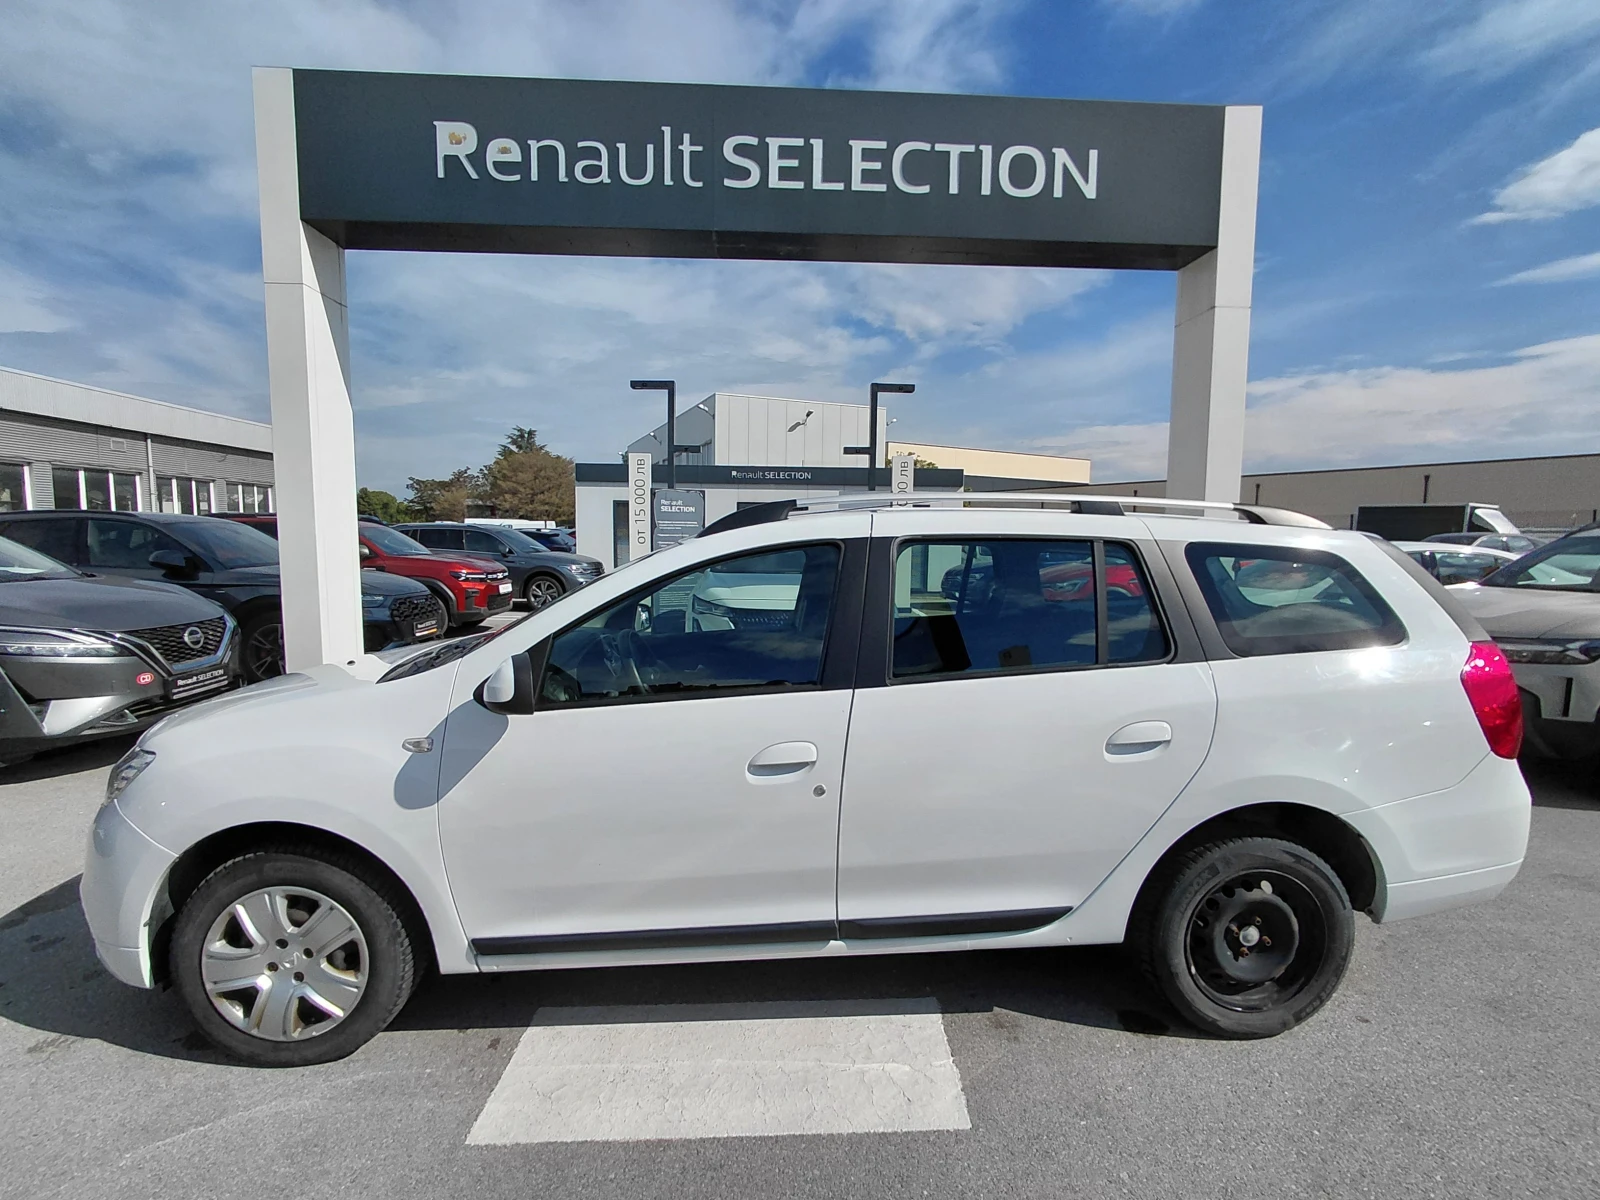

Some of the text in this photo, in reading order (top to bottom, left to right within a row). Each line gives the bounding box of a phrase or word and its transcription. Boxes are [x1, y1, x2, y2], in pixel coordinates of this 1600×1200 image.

[432, 120, 1099, 200] Renault SELECTION
[731, 470, 812, 480] Renault SELECTION
[634, 478, 646, 505] 000
[634, 508, 646, 524] 15
[660, 505, 696, 513] SELECTION
[198, 669, 224, 681] SELECTION
